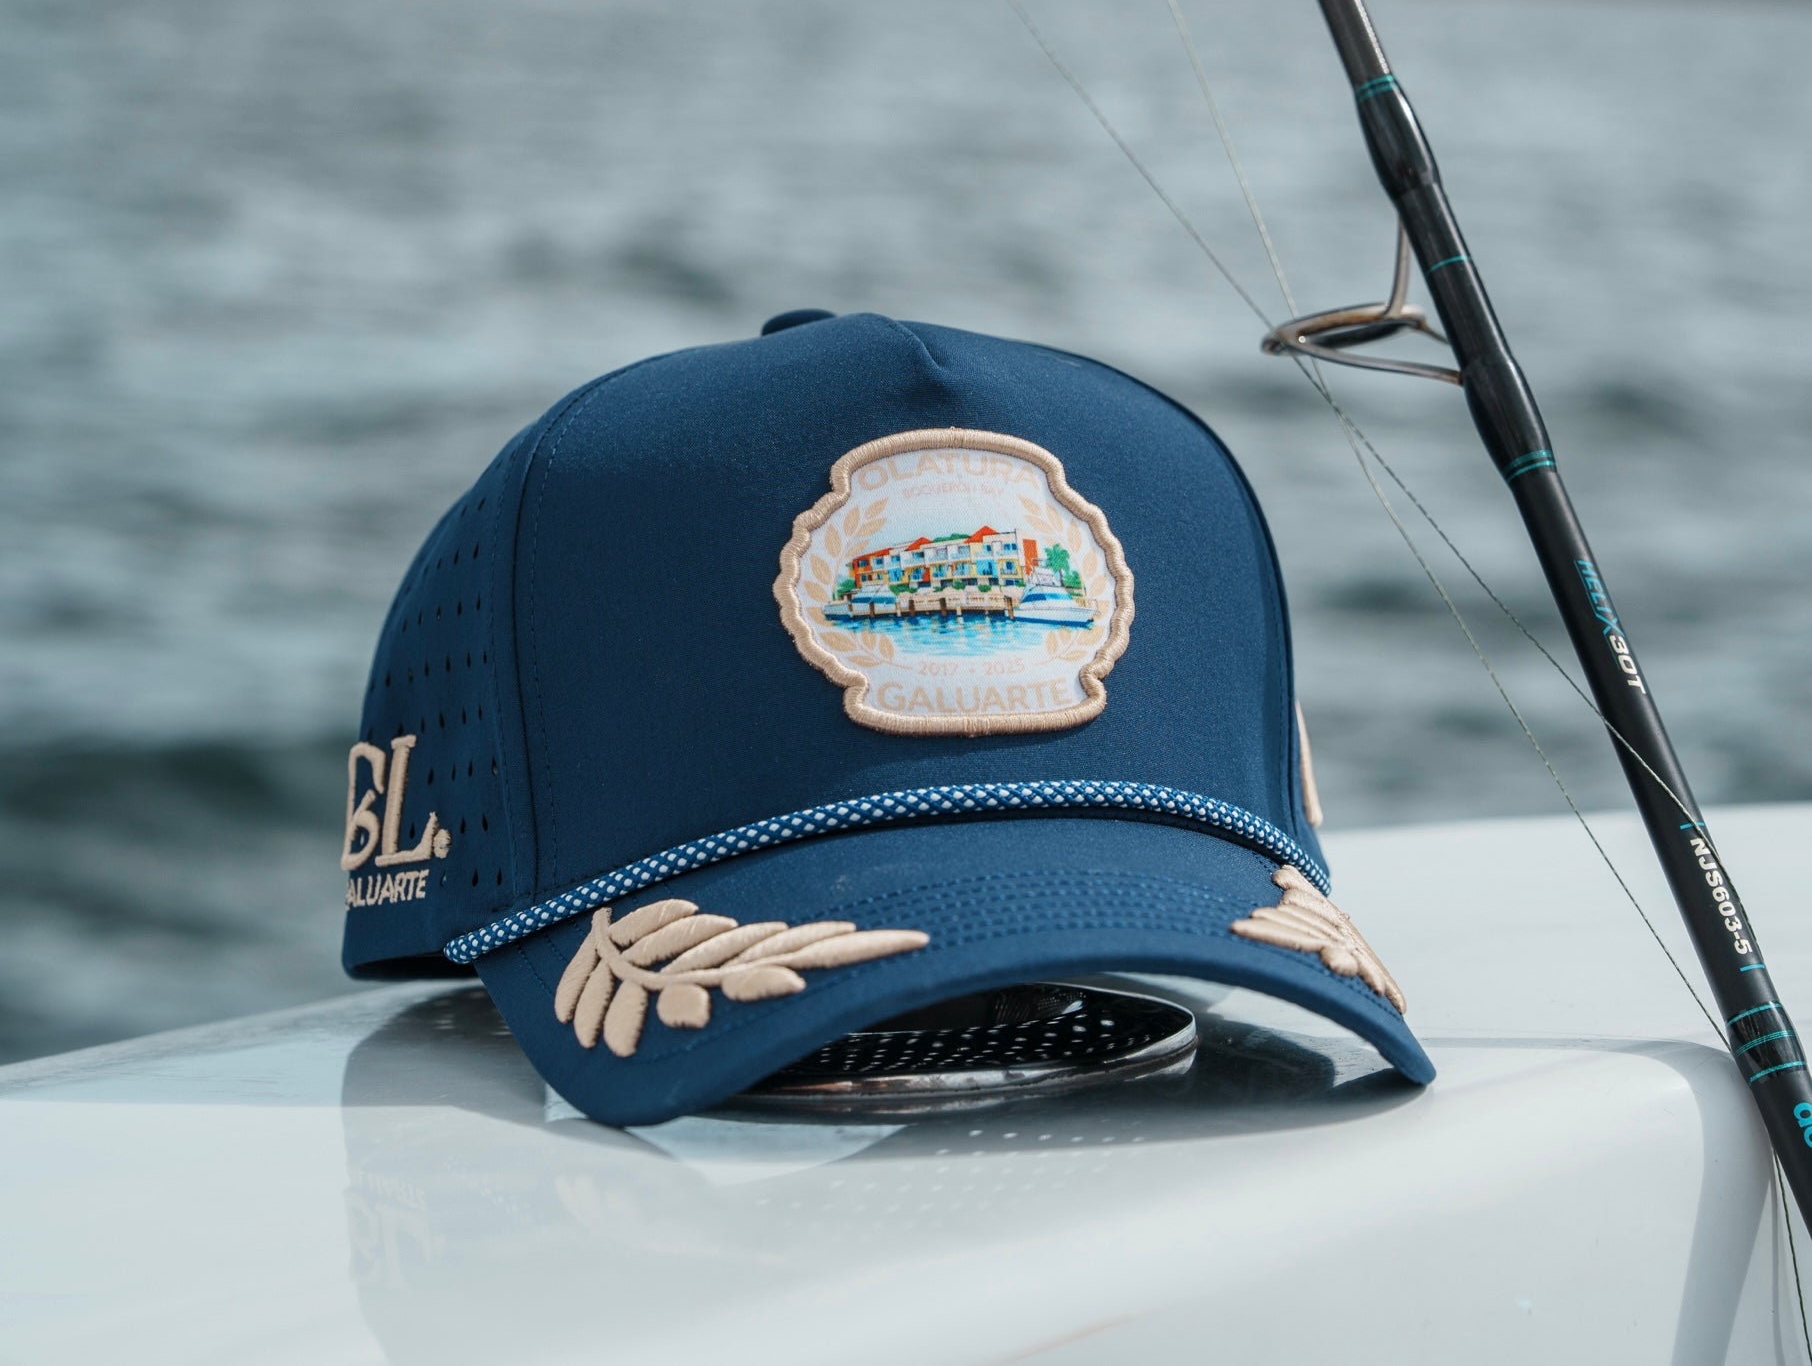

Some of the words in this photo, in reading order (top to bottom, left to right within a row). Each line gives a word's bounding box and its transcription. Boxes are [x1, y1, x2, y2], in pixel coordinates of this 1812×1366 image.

[857, 451, 1040, 491] OLATURA
[918, 660, 959, 677] 2017
[983, 656, 1026, 676] 2025
[876, 677, 1073, 713] GALUARTE
[344, 869, 430, 912] ALUARTE
[1689, 837, 1753, 955] NJS603-5
